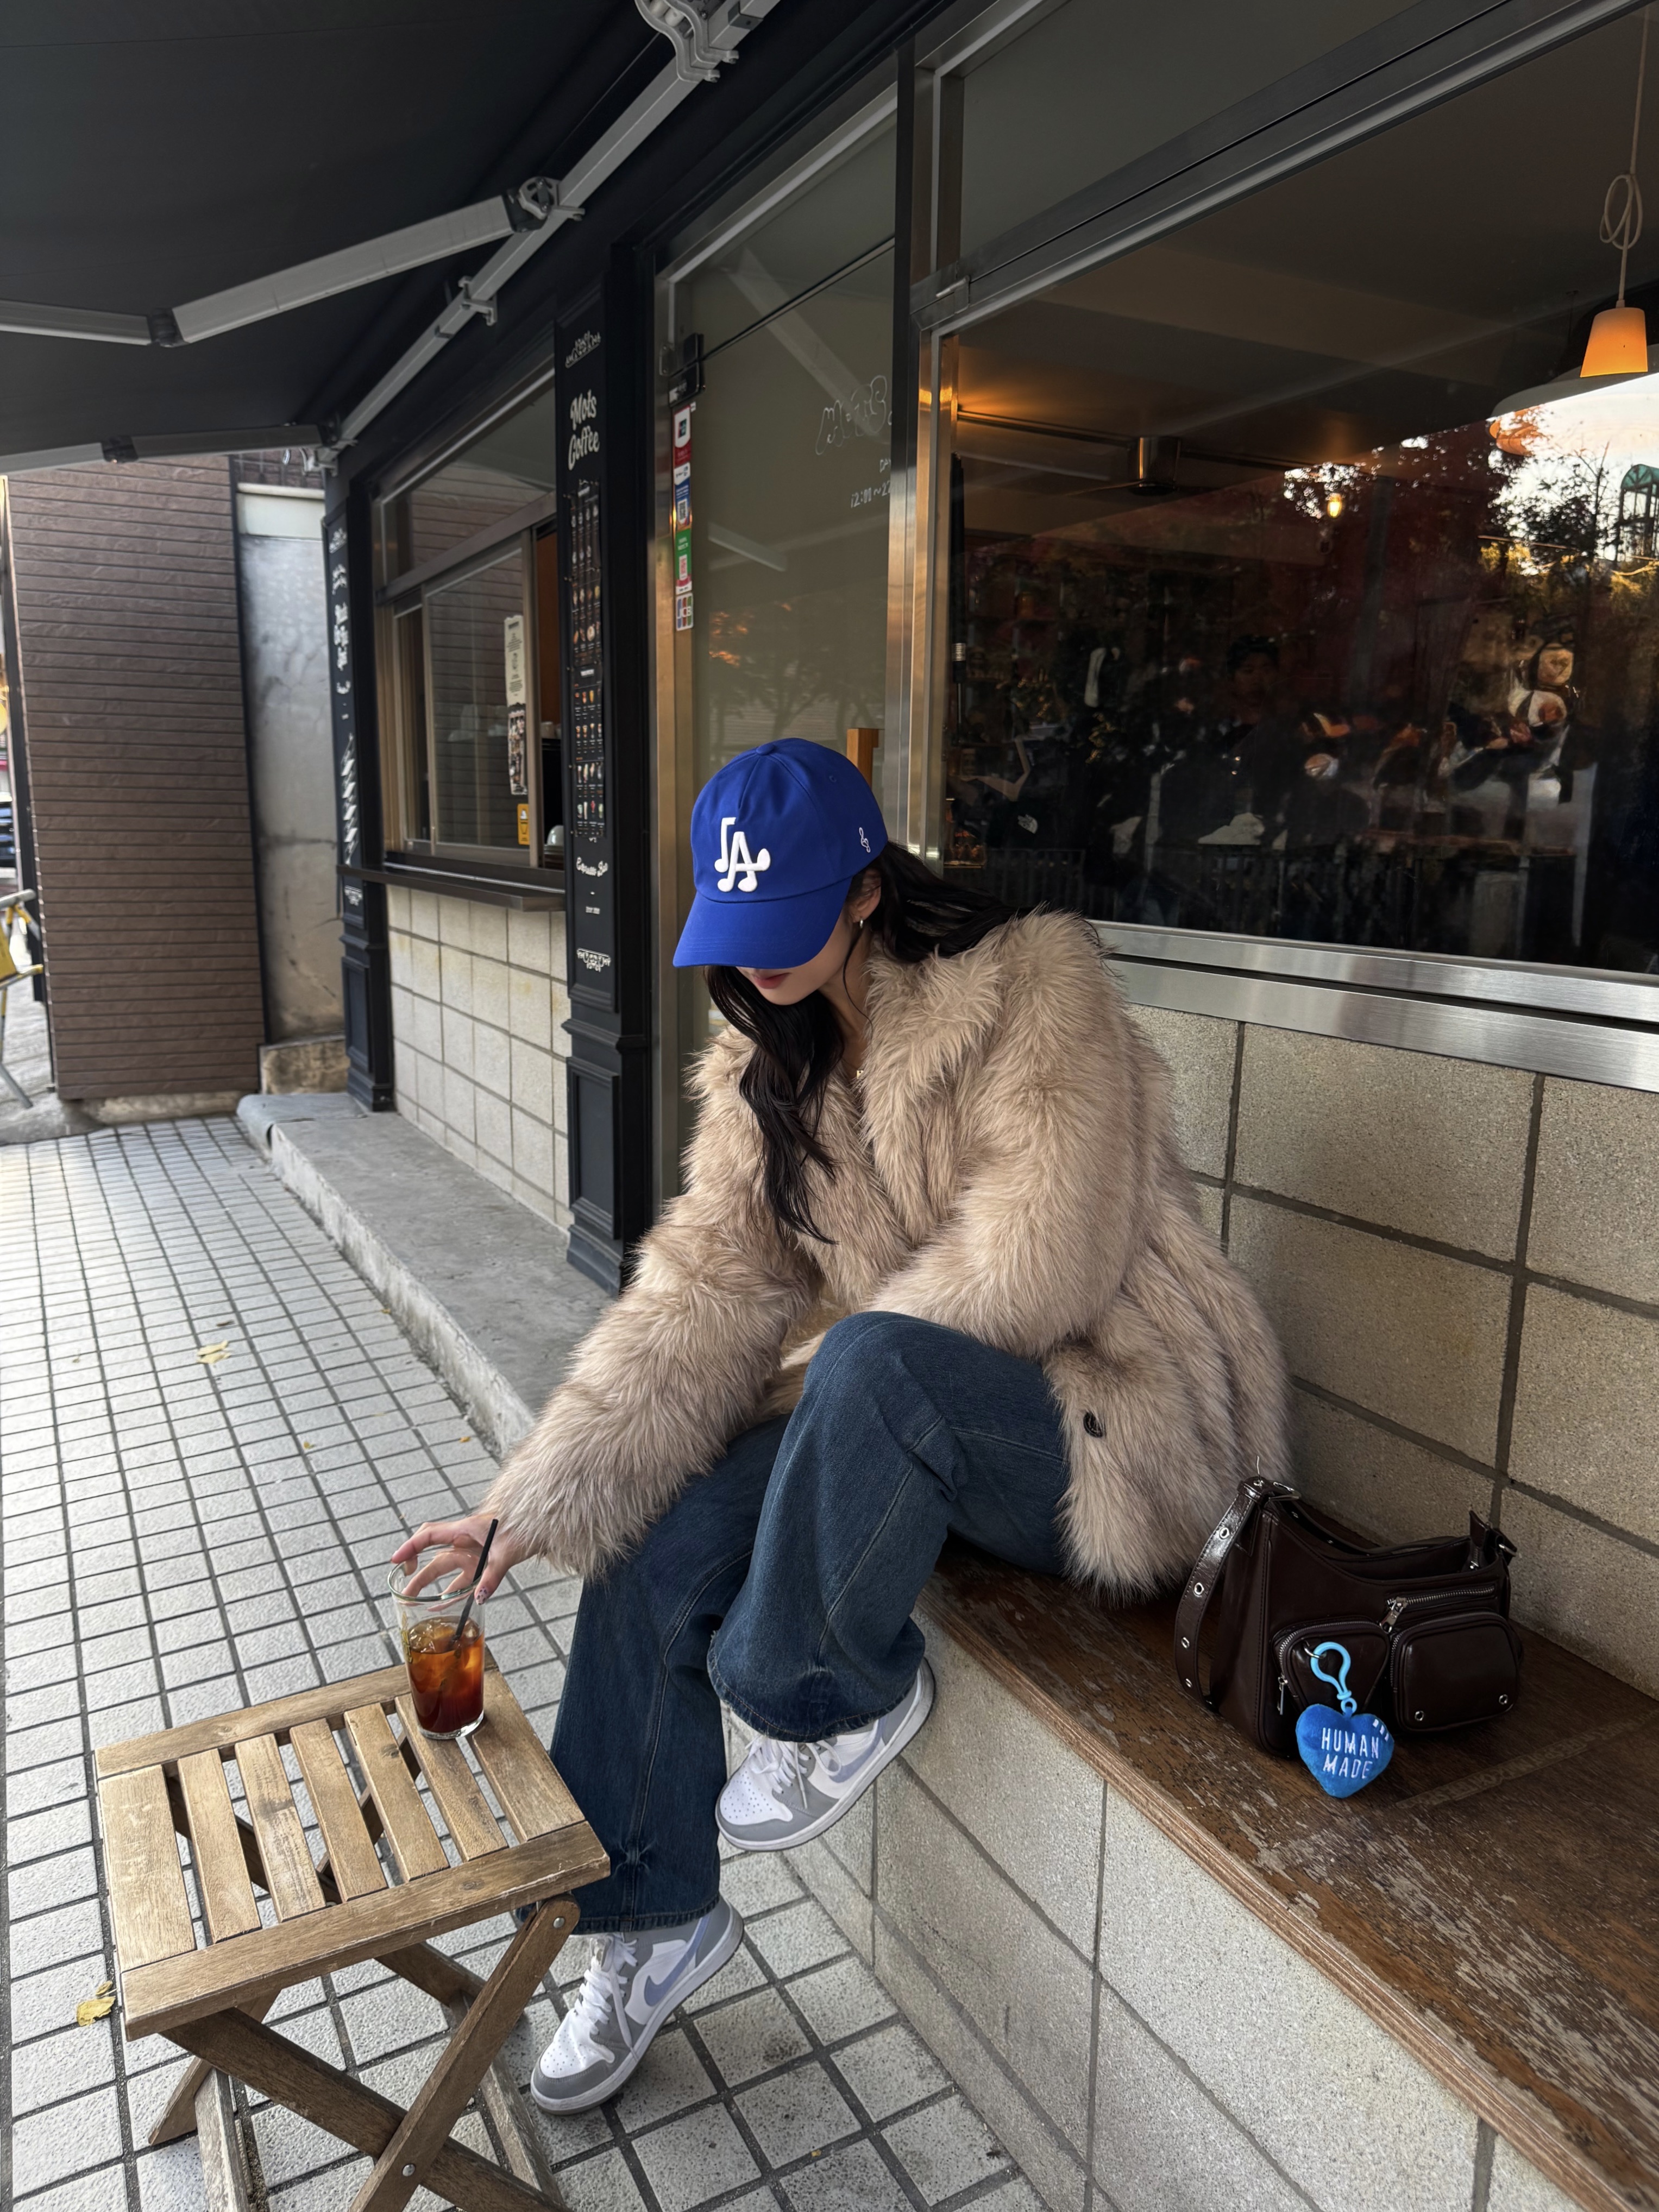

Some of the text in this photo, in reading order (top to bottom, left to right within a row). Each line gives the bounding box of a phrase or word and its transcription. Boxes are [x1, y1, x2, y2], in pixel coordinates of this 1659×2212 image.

[570, 389, 597, 431] Mots
[568, 424, 600, 471] Coffee
[1321, 1727, 1379, 1759] HUMAN
[1322, 1753, 1373, 1779] MADE
